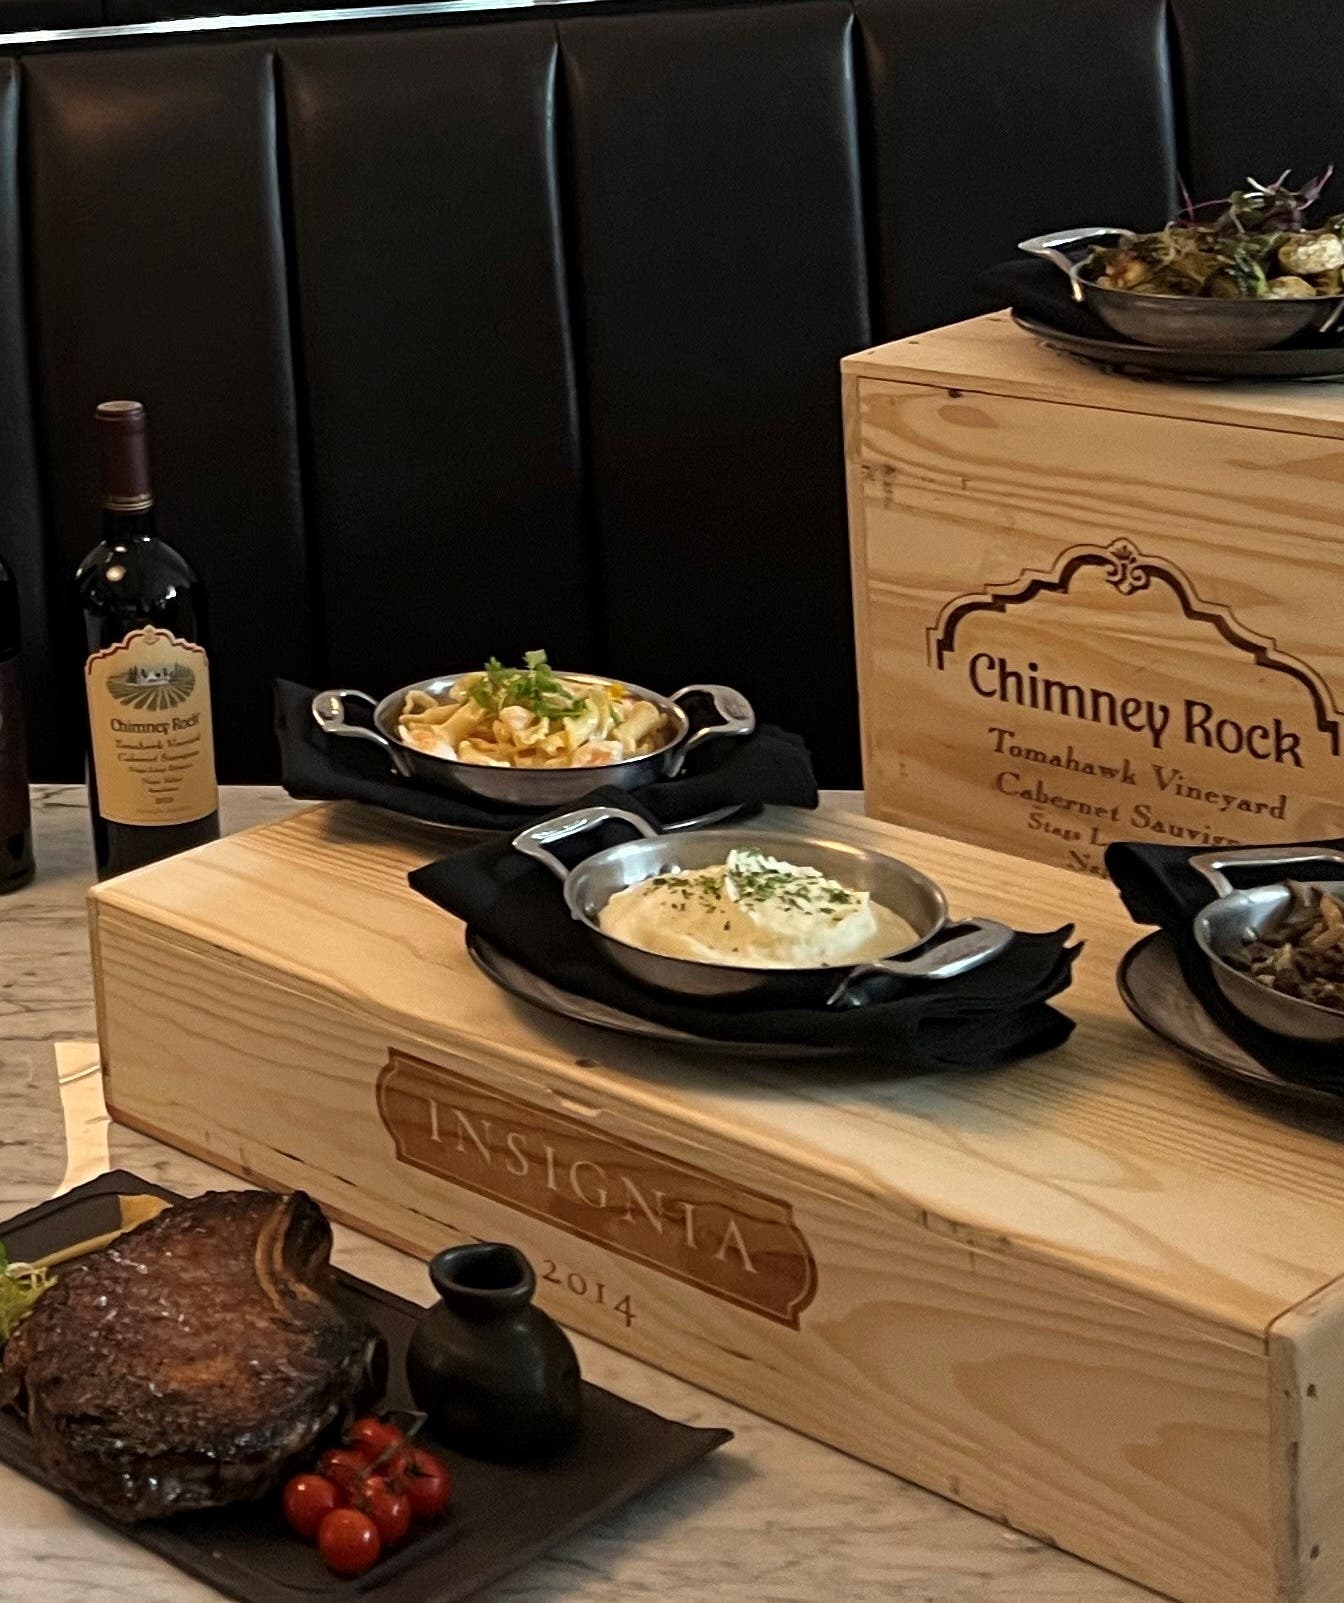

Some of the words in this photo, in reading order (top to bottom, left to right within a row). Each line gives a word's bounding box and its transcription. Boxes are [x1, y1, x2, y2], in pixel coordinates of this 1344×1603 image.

[969, 652, 1170, 749] Chimney
[1184, 699, 1305, 768] Rock
[988, 727, 1138, 785] Tomahawk
[1151, 762, 1287, 821] Vineyard
[996, 771, 1121, 822] Cabernet
[428, 1098, 758, 1274] INSIGNIA
[541, 1259, 637, 1328] 2014
